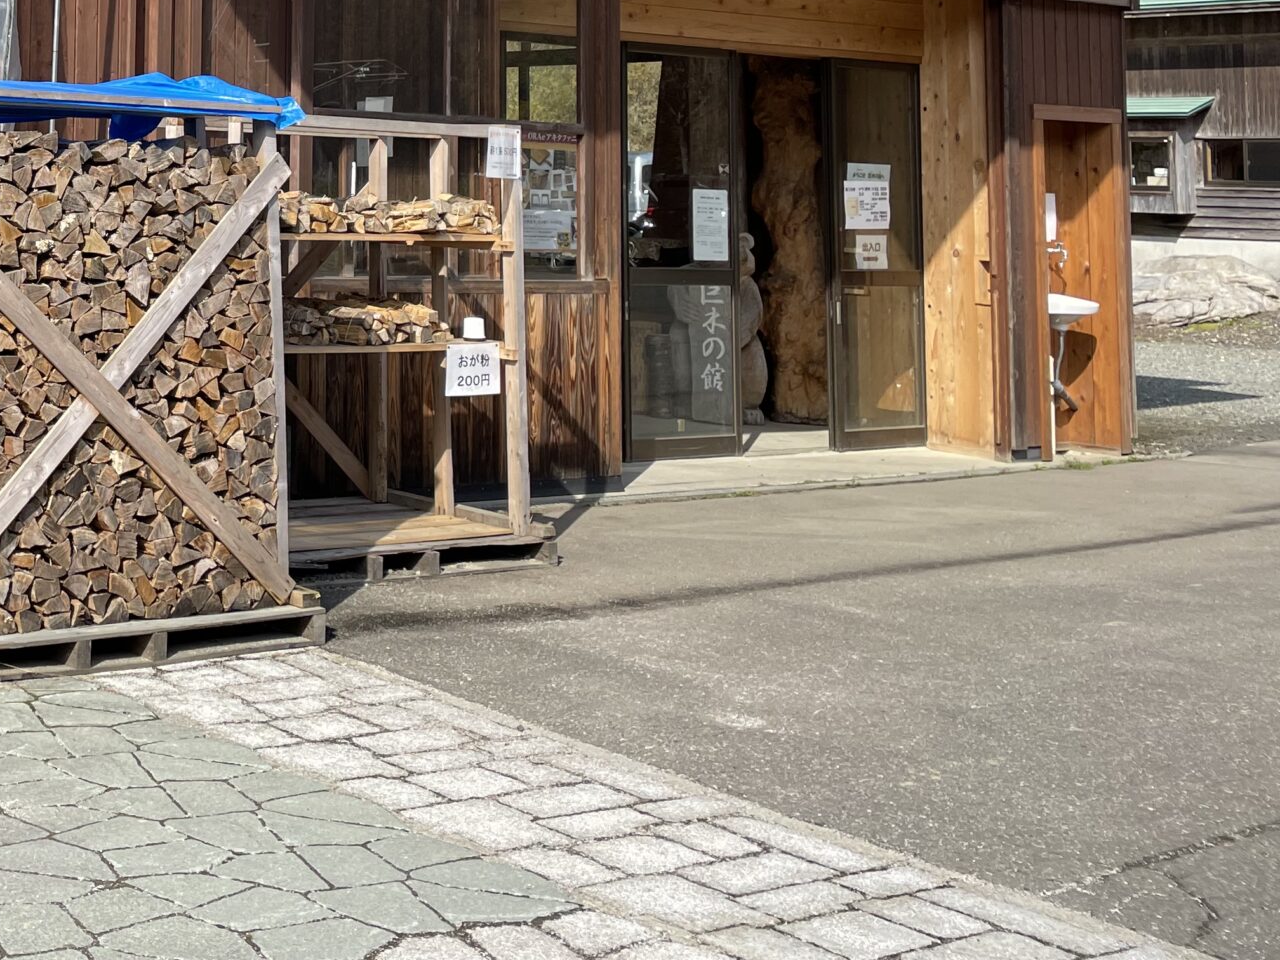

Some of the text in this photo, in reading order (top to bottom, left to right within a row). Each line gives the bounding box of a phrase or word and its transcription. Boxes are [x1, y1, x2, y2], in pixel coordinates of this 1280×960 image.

[862, 242, 881, 252] 出入口
[700, 285, 727, 392] 巨木の館
[458, 353, 490, 368] おが粉
[457, 373, 490, 387] 200円
